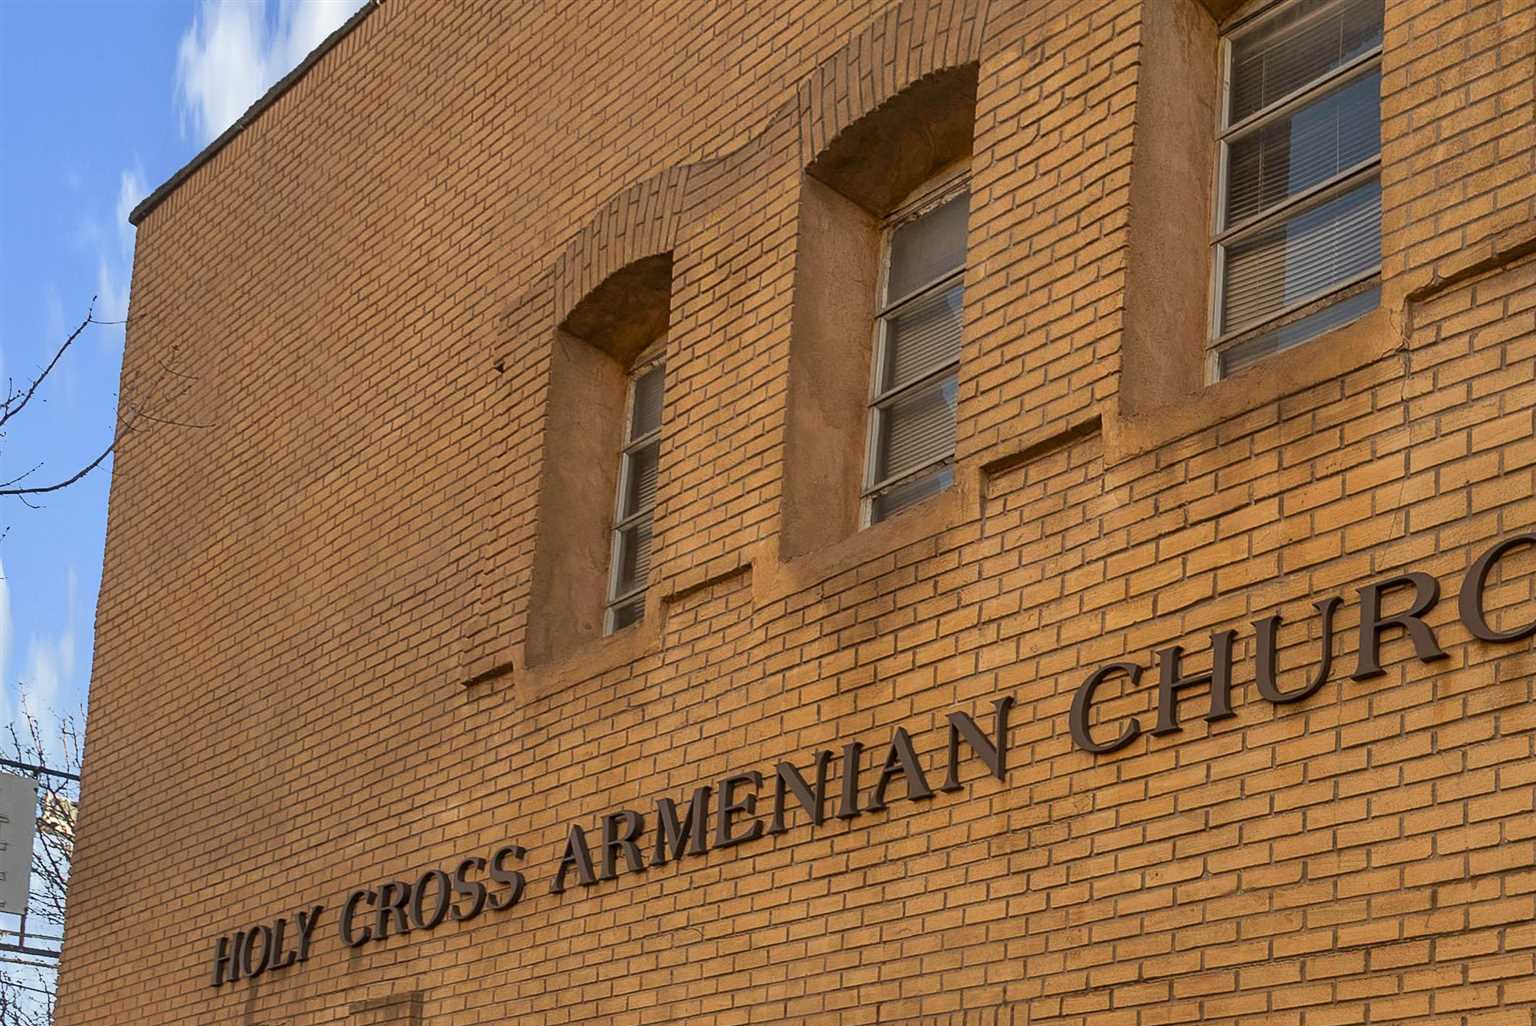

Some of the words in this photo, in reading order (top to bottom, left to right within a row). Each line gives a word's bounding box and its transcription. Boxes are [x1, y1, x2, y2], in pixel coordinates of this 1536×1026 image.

[210, 905, 324, 987] HOLY
[338, 845, 526, 947] CROSS
[549, 695, 1016, 894] ARMENIAN
